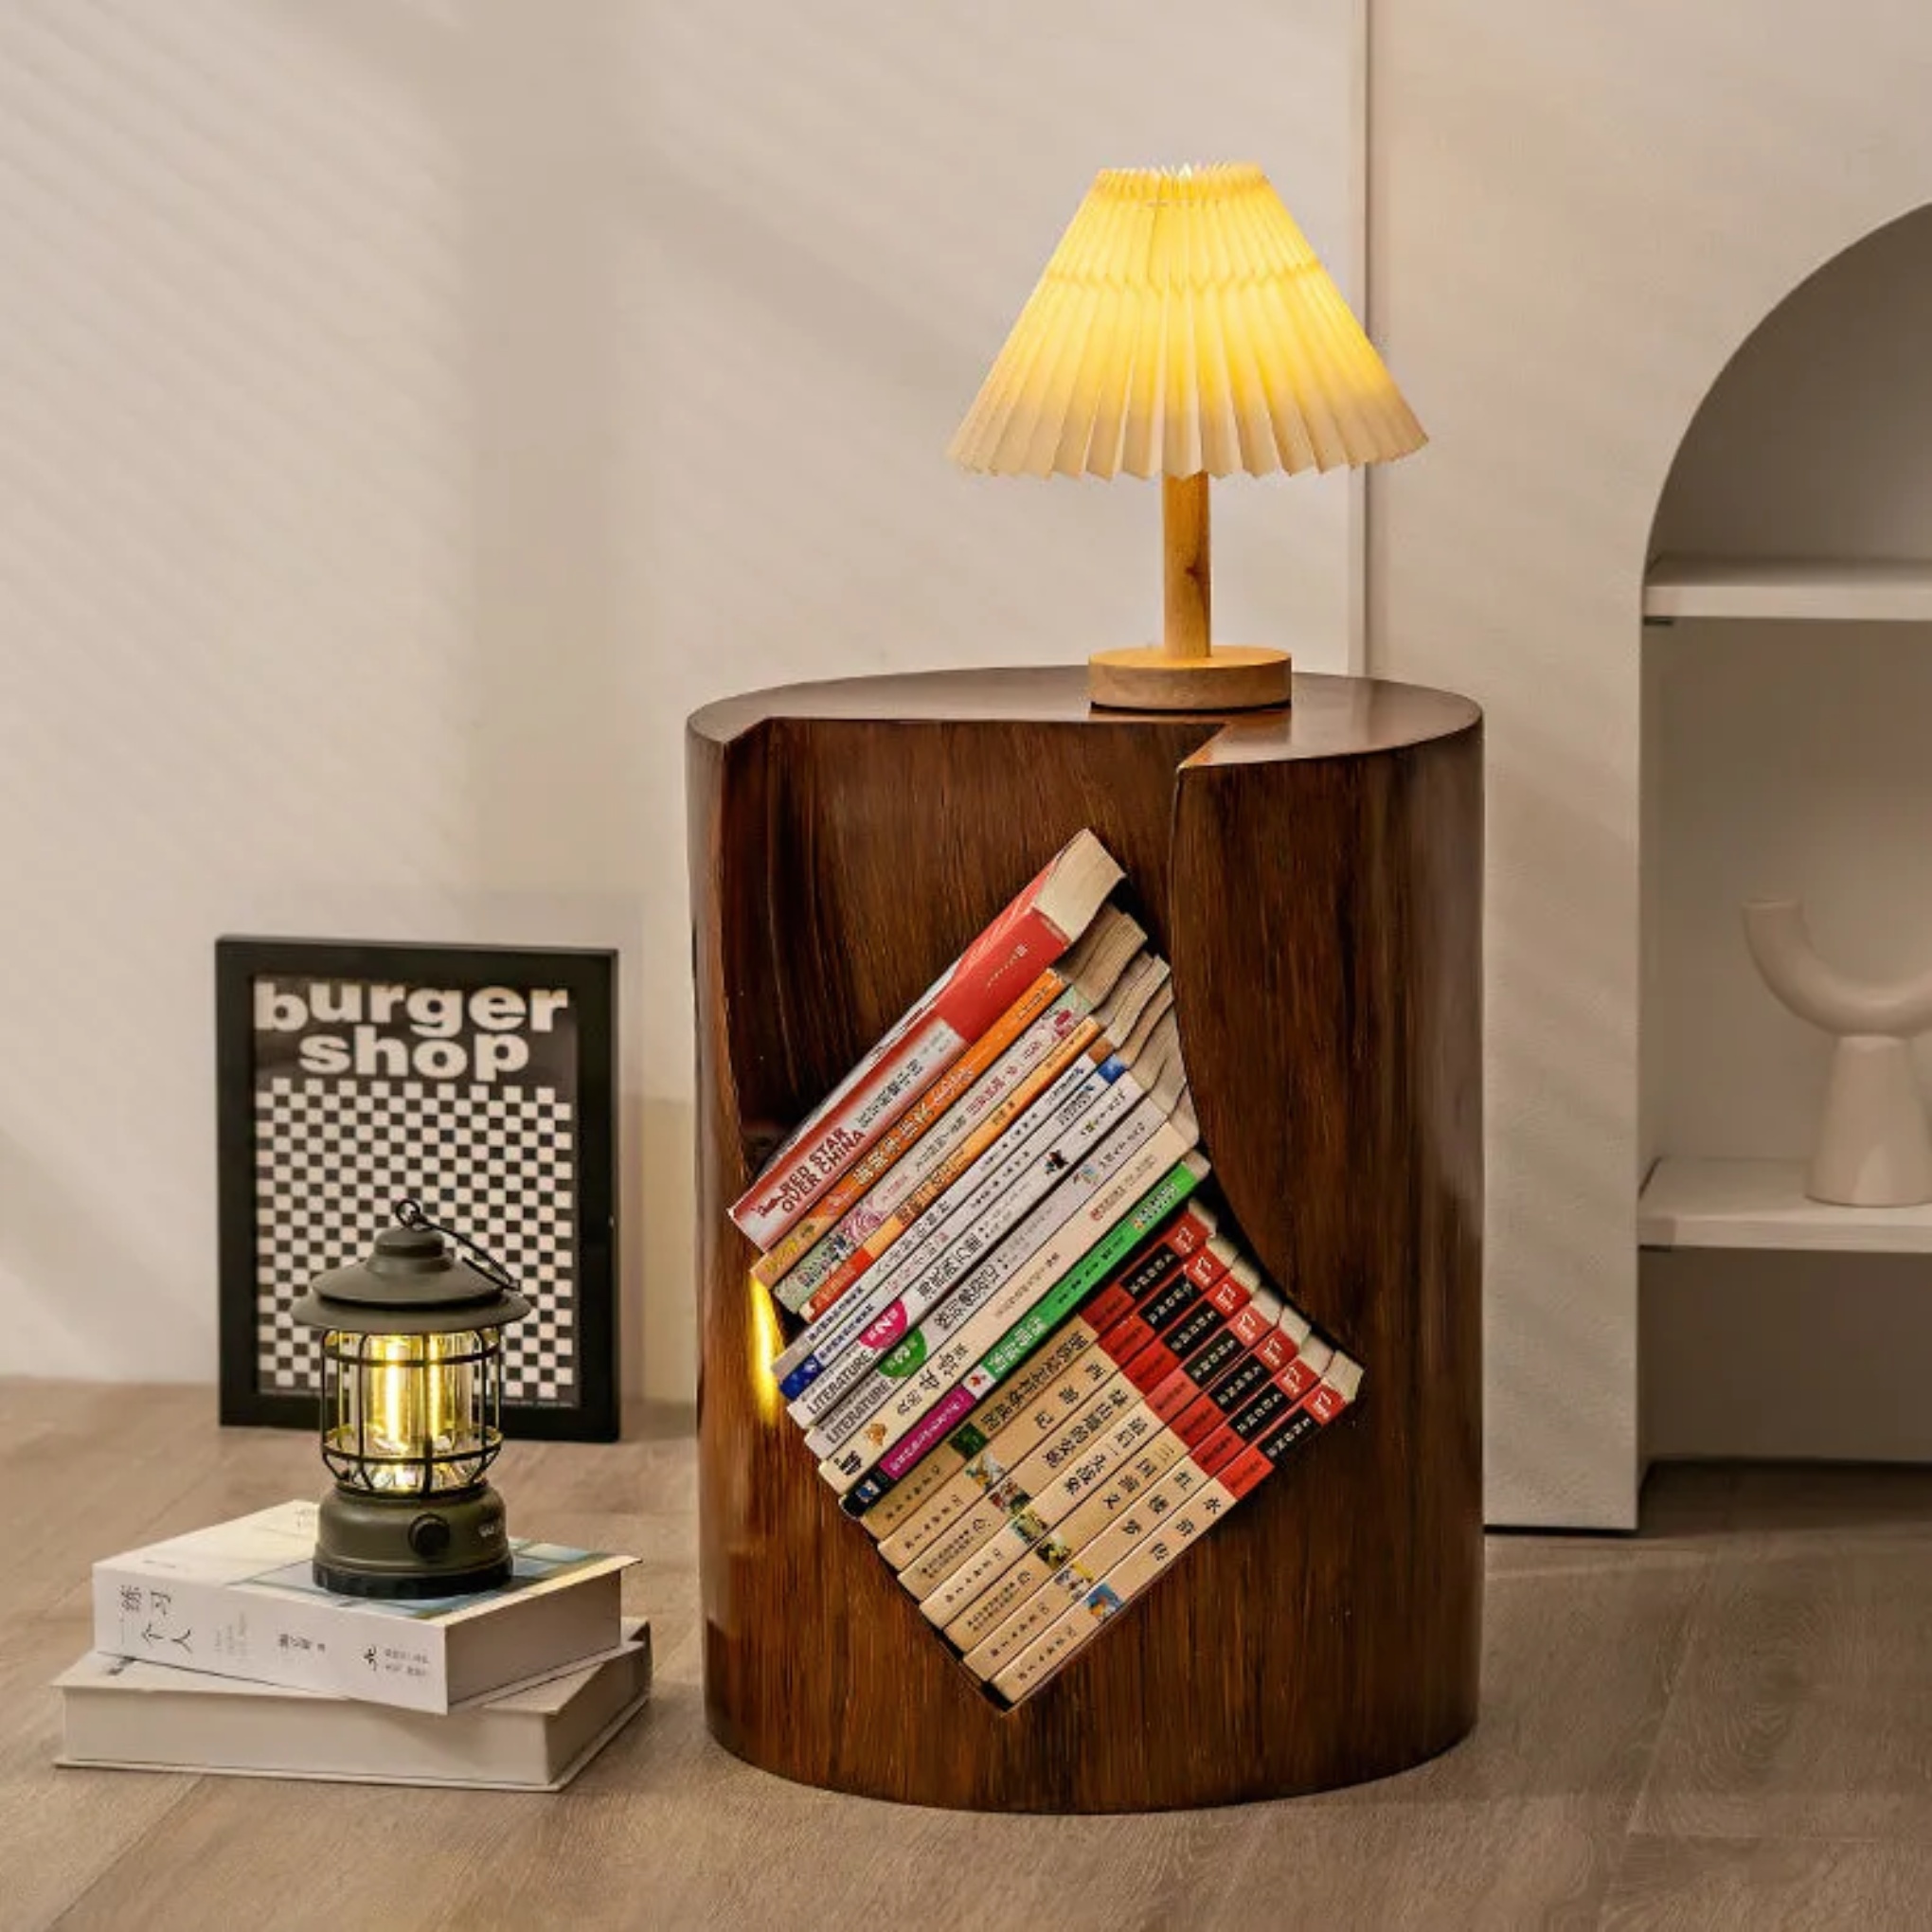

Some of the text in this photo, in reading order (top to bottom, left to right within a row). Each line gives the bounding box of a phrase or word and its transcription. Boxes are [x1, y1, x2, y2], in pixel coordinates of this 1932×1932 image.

[254, 980, 569, 1038] burger
[298, 1025, 529, 1082] shop
[854, 1058, 923, 1128] 红星照耀中国
[775, 1125, 847, 1199] RED STAR
[778, 1128, 866, 1213] OVER CHINA
[914, 1232, 985, 1302] 海底两万里
[931, 1262, 1002, 1333] 格列佛游记
[805, 1349, 873, 1415] LITERATURE
[823, 1377, 893, 1444] LITERATURE
[1032, 1360, 1105, 1431] 西游记
[1041, 1386, 1130, 1469] 绿山墙的安妮
[1061, 1415, 1150, 1496] 最后一头战象
[1100, 1440, 1175, 1511] 三国演义
[1119, 1469, 1195, 1539] 红楼梦
[1148, 1494, 1224, 1564] 水浒传
